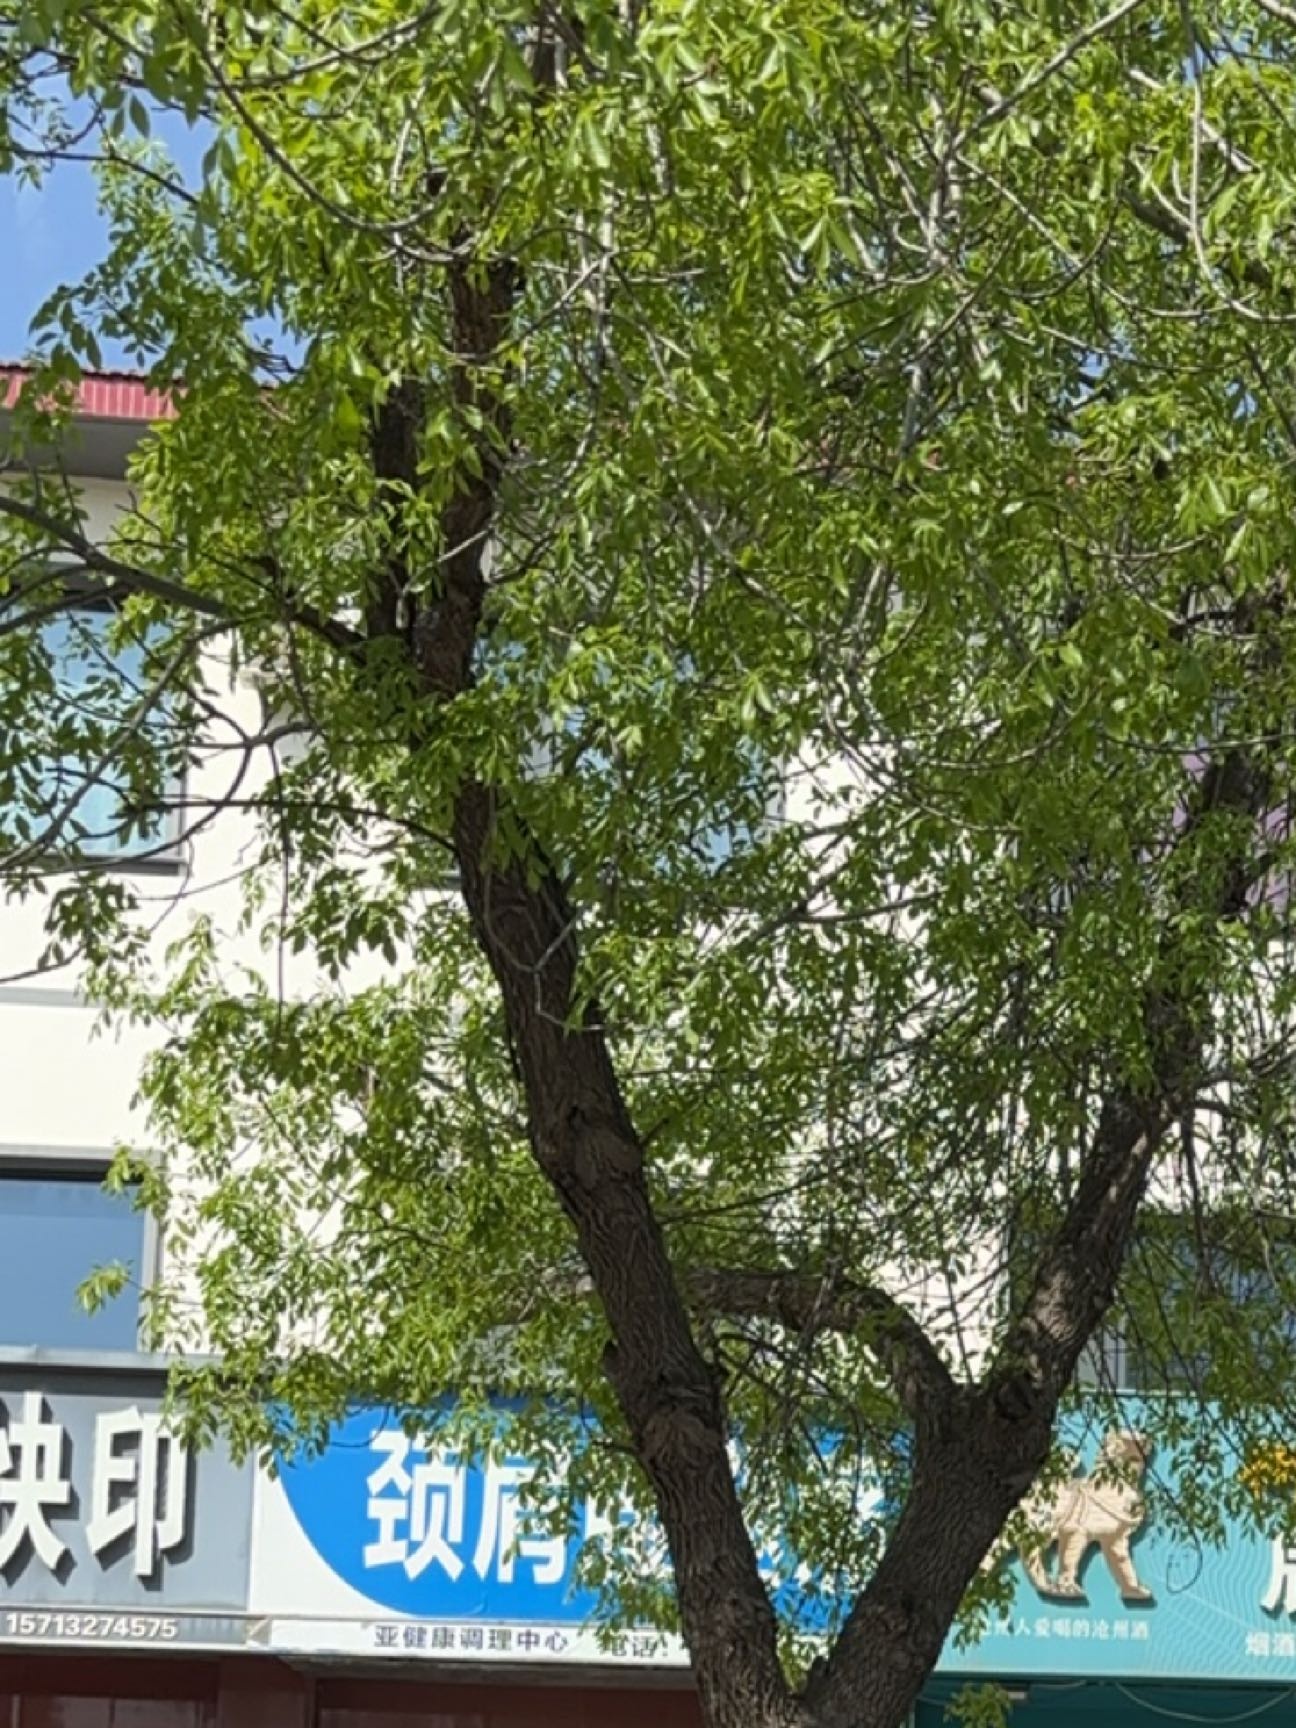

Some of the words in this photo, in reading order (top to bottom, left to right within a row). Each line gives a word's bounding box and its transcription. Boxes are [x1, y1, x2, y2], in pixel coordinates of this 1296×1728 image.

[0, 1391, 188, 1576] 快印
[6, 1614, 178, 1639] 15713274575
[374, 1625, 568, 1652] 亚健康调理中心
